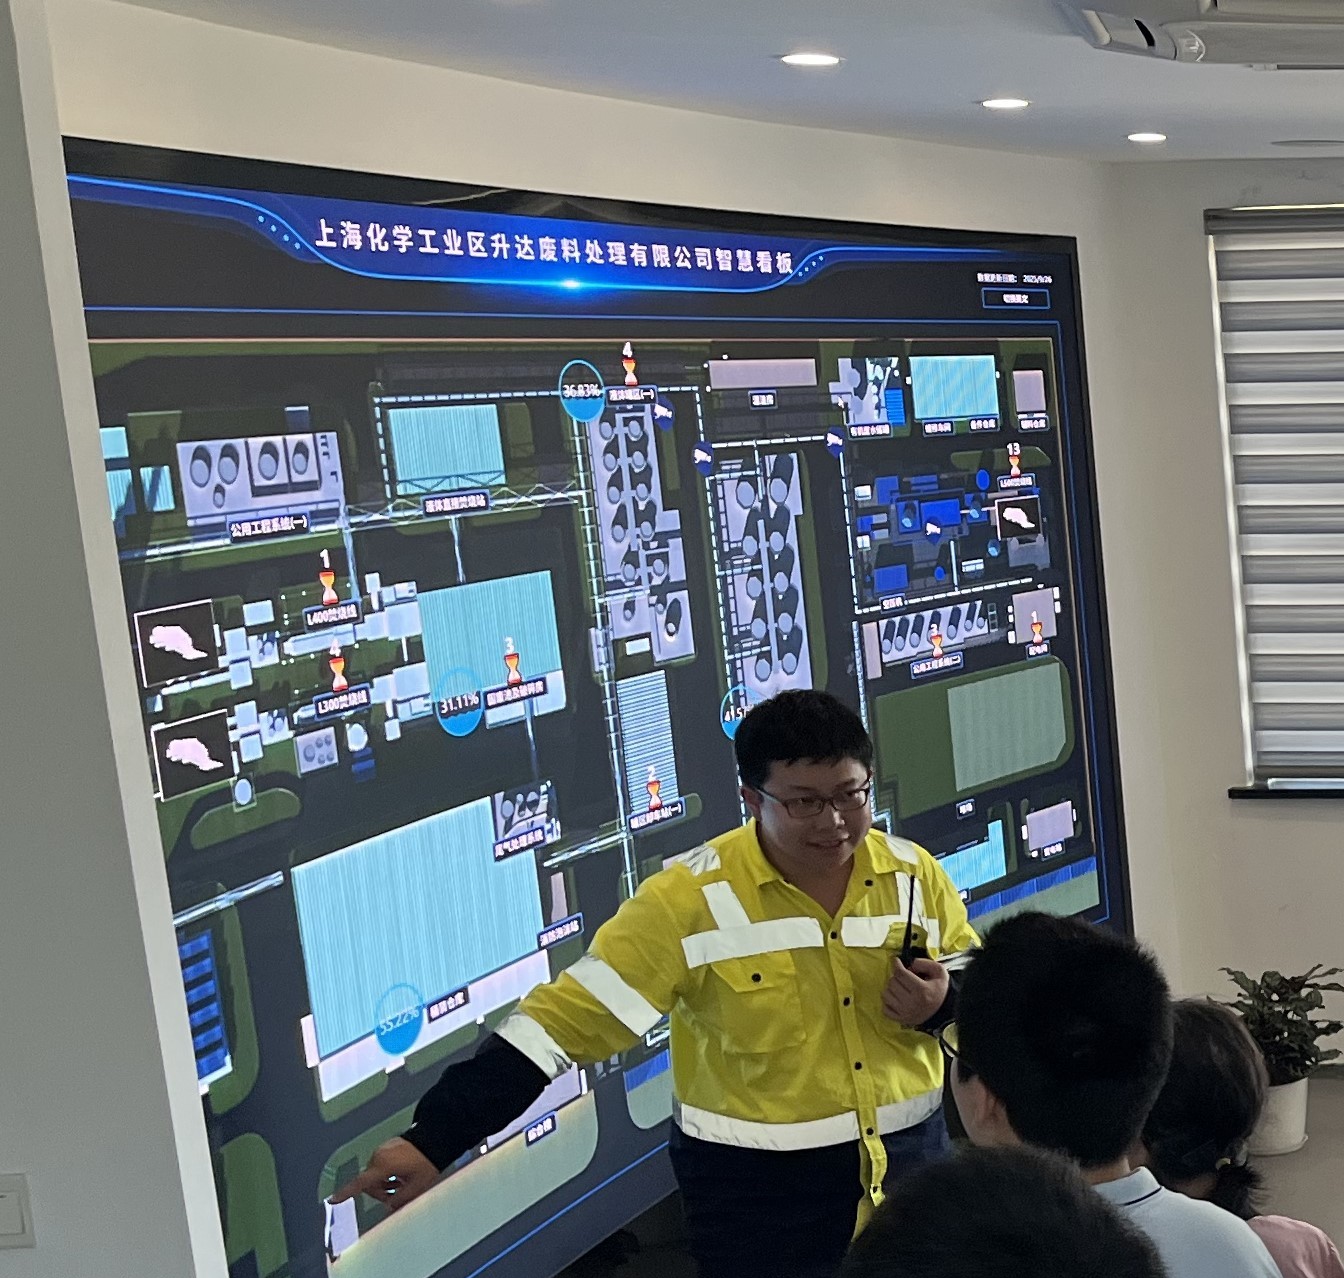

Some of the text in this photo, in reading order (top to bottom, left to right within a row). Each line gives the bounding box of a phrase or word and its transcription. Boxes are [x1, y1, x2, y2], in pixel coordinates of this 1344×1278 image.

[315, 218, 794, 274] 上海化学工业区升达废料处理有限公司智慧看板
[623, 341, 634, 357] 4
[562, 384, 601, 398] 36.83%
[1006, 442, 1021, 455] 13
[319, 549, 330, 568] 1
[440, 691, 480, 714] 31.11%
[647, 765, 657, 780] 2
[380, 1010, 420, 1036] 55.22%
